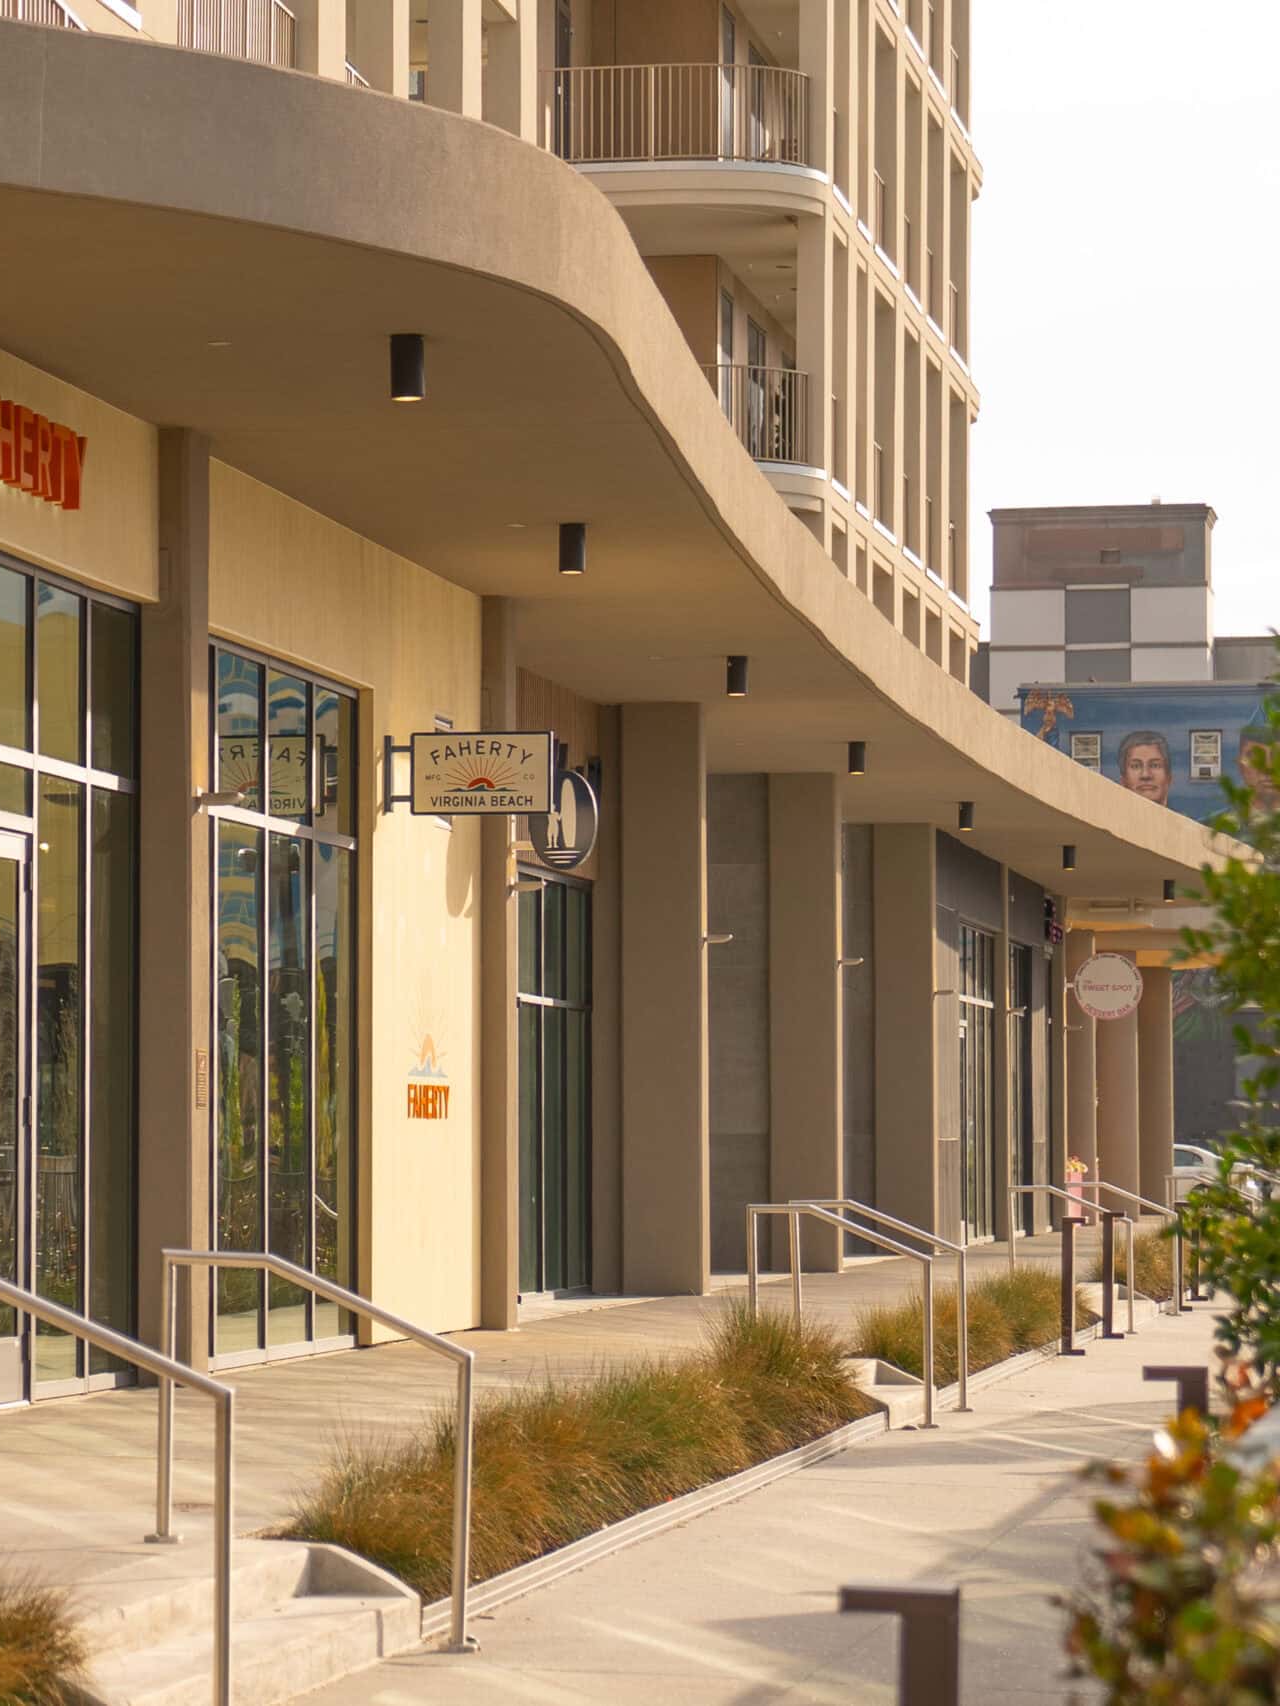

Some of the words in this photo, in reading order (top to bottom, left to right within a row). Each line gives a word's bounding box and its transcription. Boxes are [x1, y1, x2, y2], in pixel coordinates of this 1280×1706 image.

[430, 740, 534, 765] FAHERTY
[431, 796, 487, 807] VIRGINIA
[491, 795, 534, 807] BEACH
[1111, 984, 1132, 992] SPOT
[407, 1083, 450, 1120] FAHERTY
